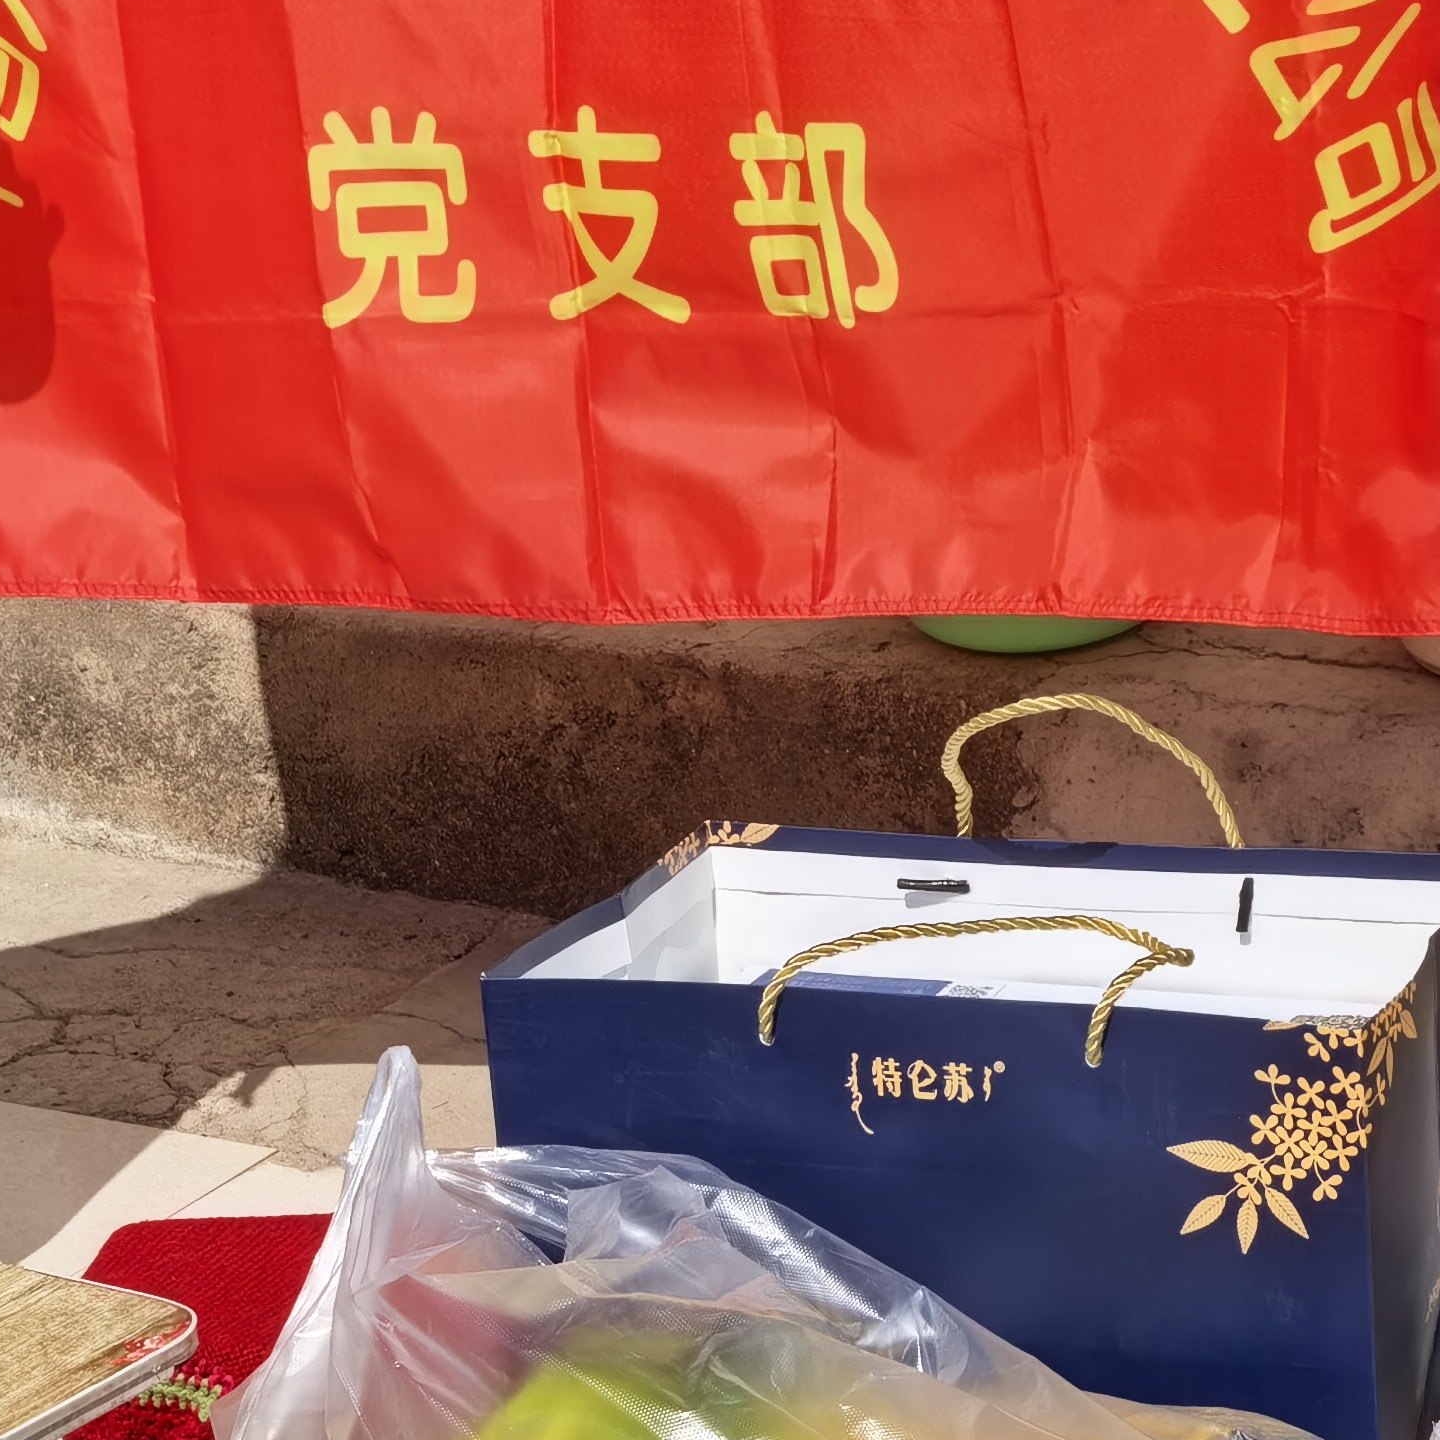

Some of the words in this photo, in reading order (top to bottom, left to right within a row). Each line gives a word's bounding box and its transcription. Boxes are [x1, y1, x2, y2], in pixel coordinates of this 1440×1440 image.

[310, 104, 899, 328] 党支部
[872, 1056, 975, 1103] 特仑苏
